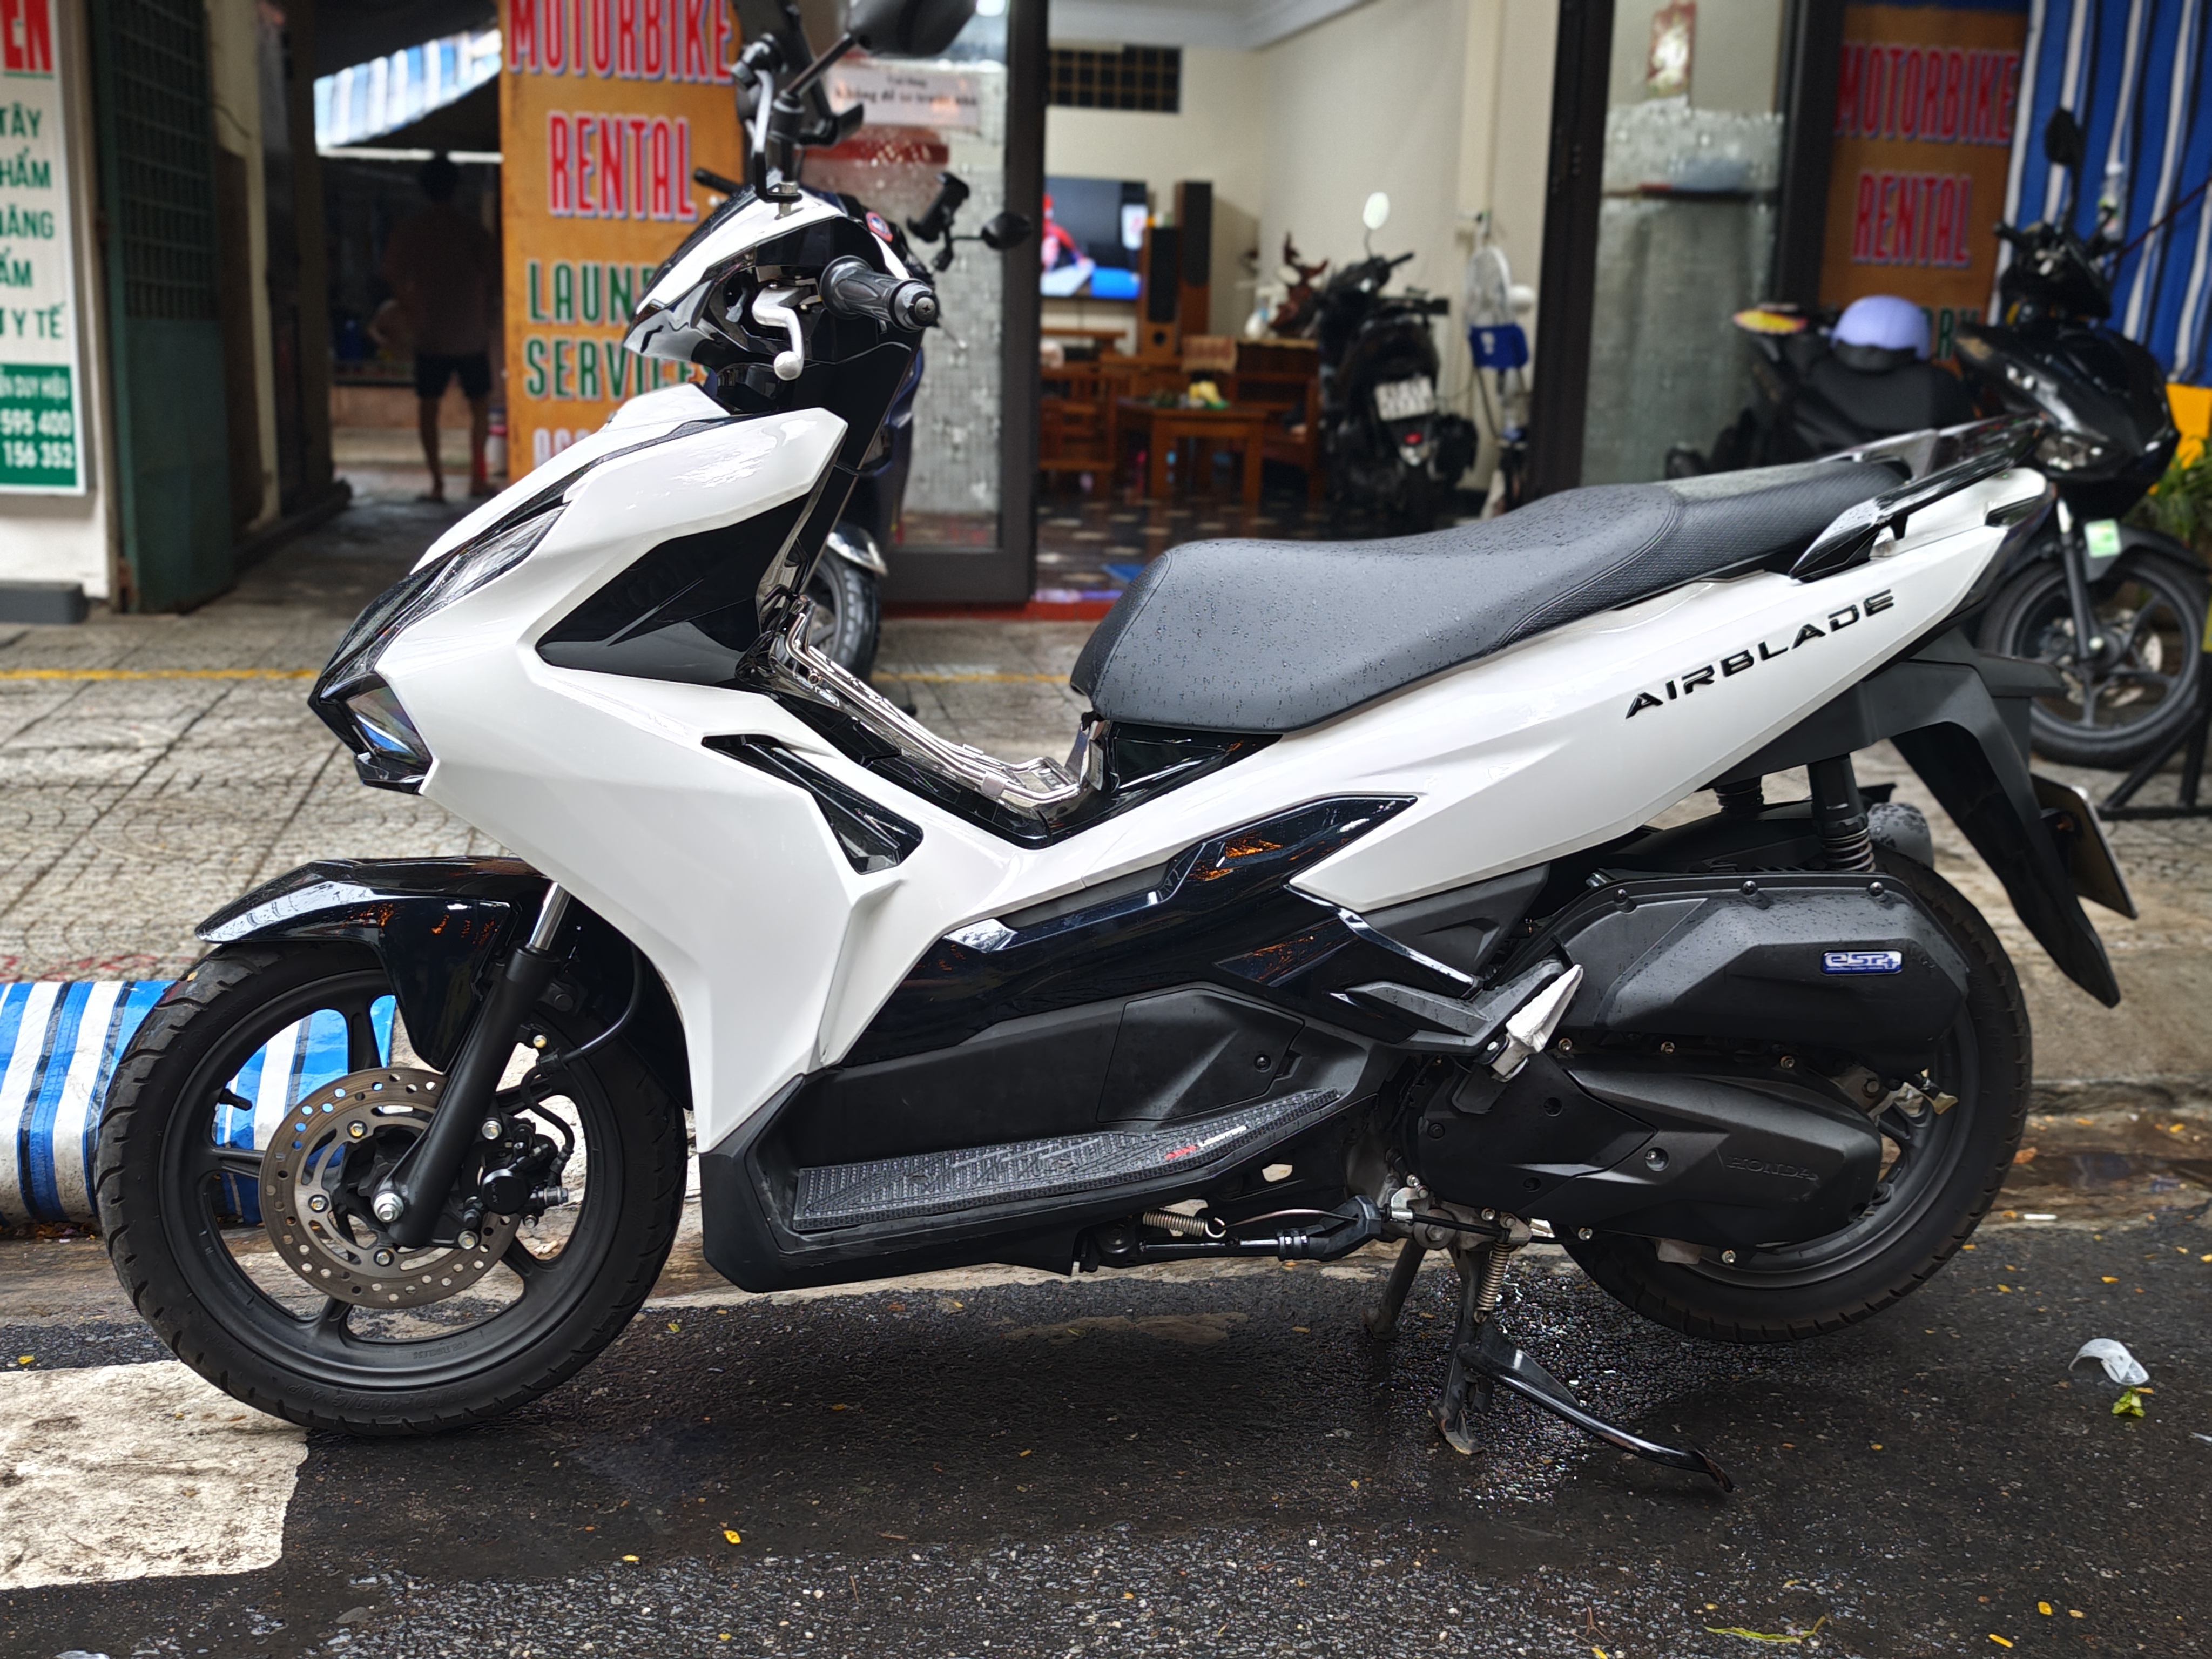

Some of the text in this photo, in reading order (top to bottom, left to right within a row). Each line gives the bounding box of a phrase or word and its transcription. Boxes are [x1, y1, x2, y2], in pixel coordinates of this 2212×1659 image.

[508, 0, 733, 84] MOTORBIKE
[1834, 42, 2019, 146] MOTORBIKE
[548, 111, 698, 221] RENTAL
[1852, 169, 1972, 268] RENTAL
[524, 337, 711, 400] SERVI
[1626, 589, 1894, 719] AIRBLADE
[1727, 1157, 1819, 1181] HONDA
